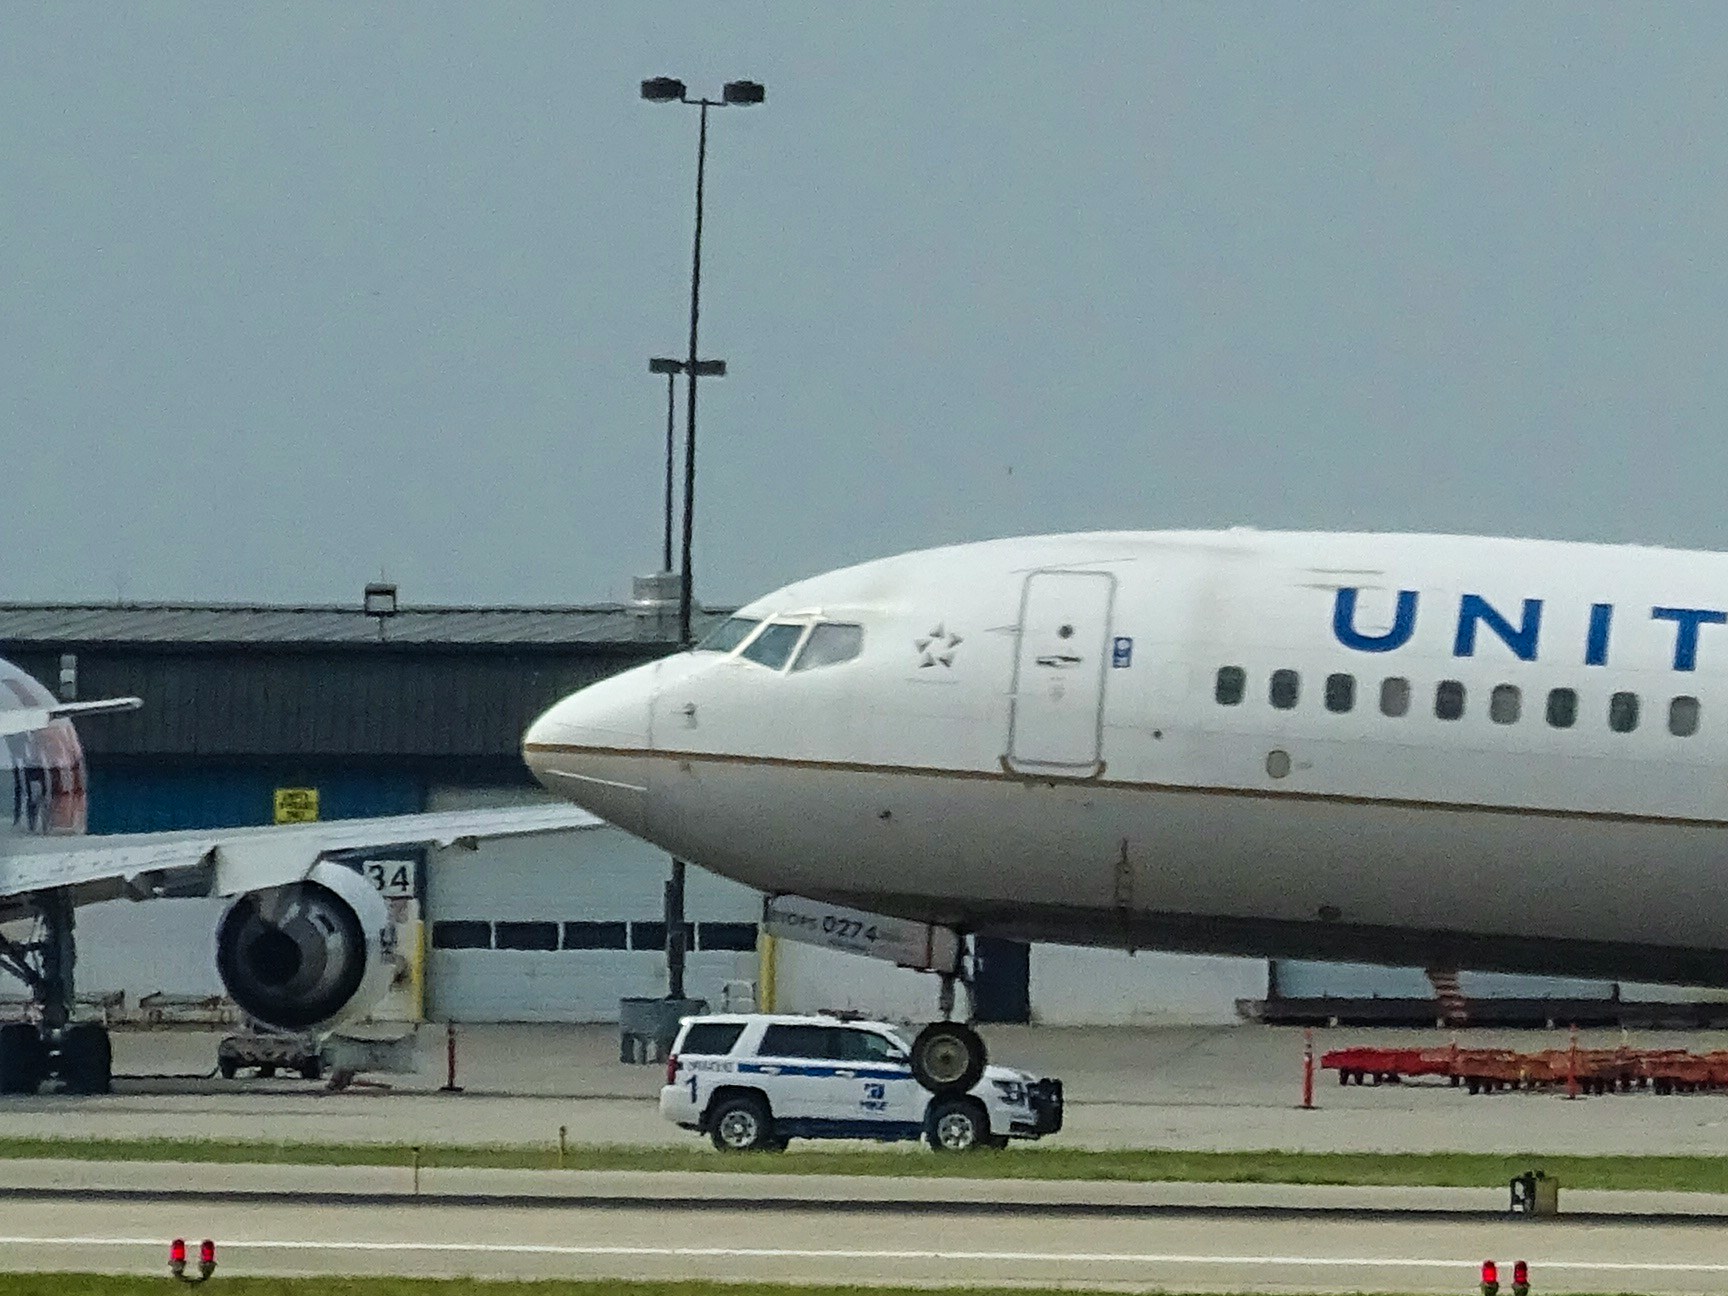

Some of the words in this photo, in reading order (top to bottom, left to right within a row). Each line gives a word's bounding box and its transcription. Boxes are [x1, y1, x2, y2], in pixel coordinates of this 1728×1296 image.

[368, 864, 410, 892] 34
[822, 915, 879, 943] 0274
[685, 1074, 697, 1104] 1
